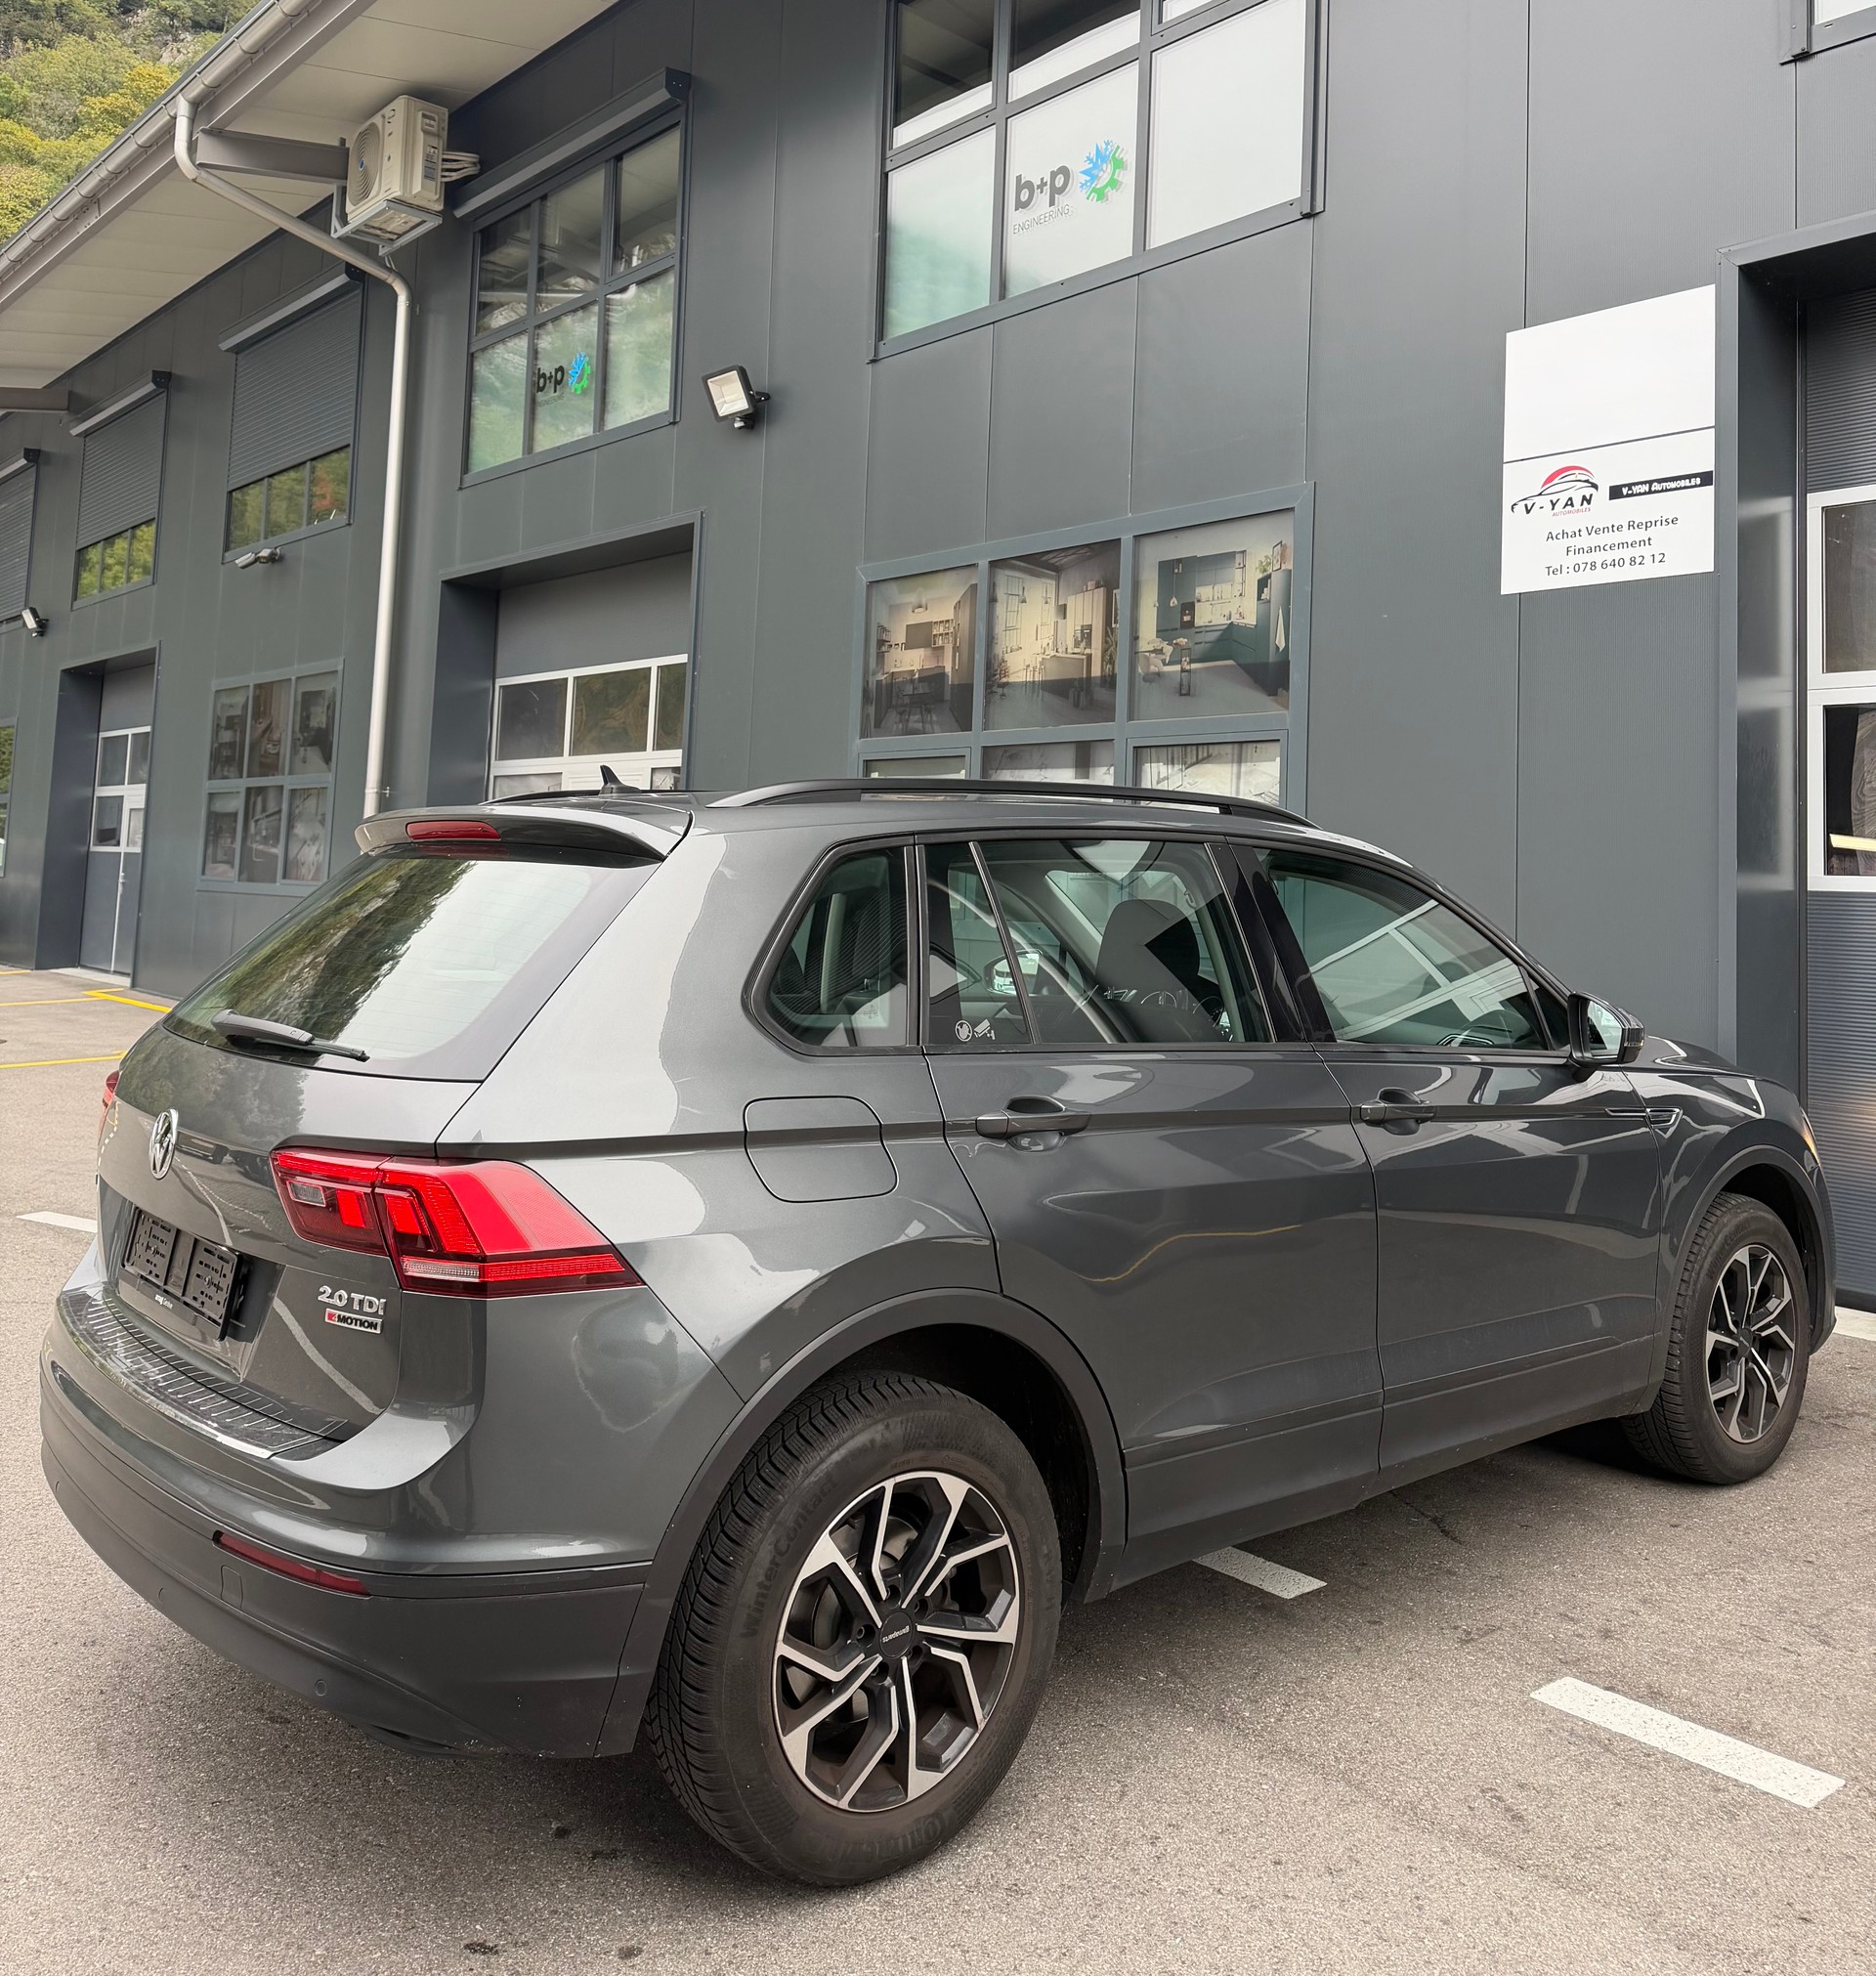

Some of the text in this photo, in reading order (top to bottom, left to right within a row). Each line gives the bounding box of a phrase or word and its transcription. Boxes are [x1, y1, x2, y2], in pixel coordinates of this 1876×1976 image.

[1014, 165, 1071, 212] b+p
[1012, 203, 1071, 235] ENGINEERING
[536, 365, 565, 394] b+p
[1622, 483, 1649, 495] V-YAN
[1523, 493, 1594, 515] V-YAN
[1552, 506, 1592, 517] AUTOMOBILES
[1546, 515, 1679, 541] Achat Vente Reprise
[1565, 536, 1653, 557] Financement
[1573, 560, 1598, 574] 078
[1600, 557, 1626, 570] 640
[1629, 554, 1645, 567] 82
[1649, 551, 1666, 564] 12
[350, 1292, 387, 1315] TDI
